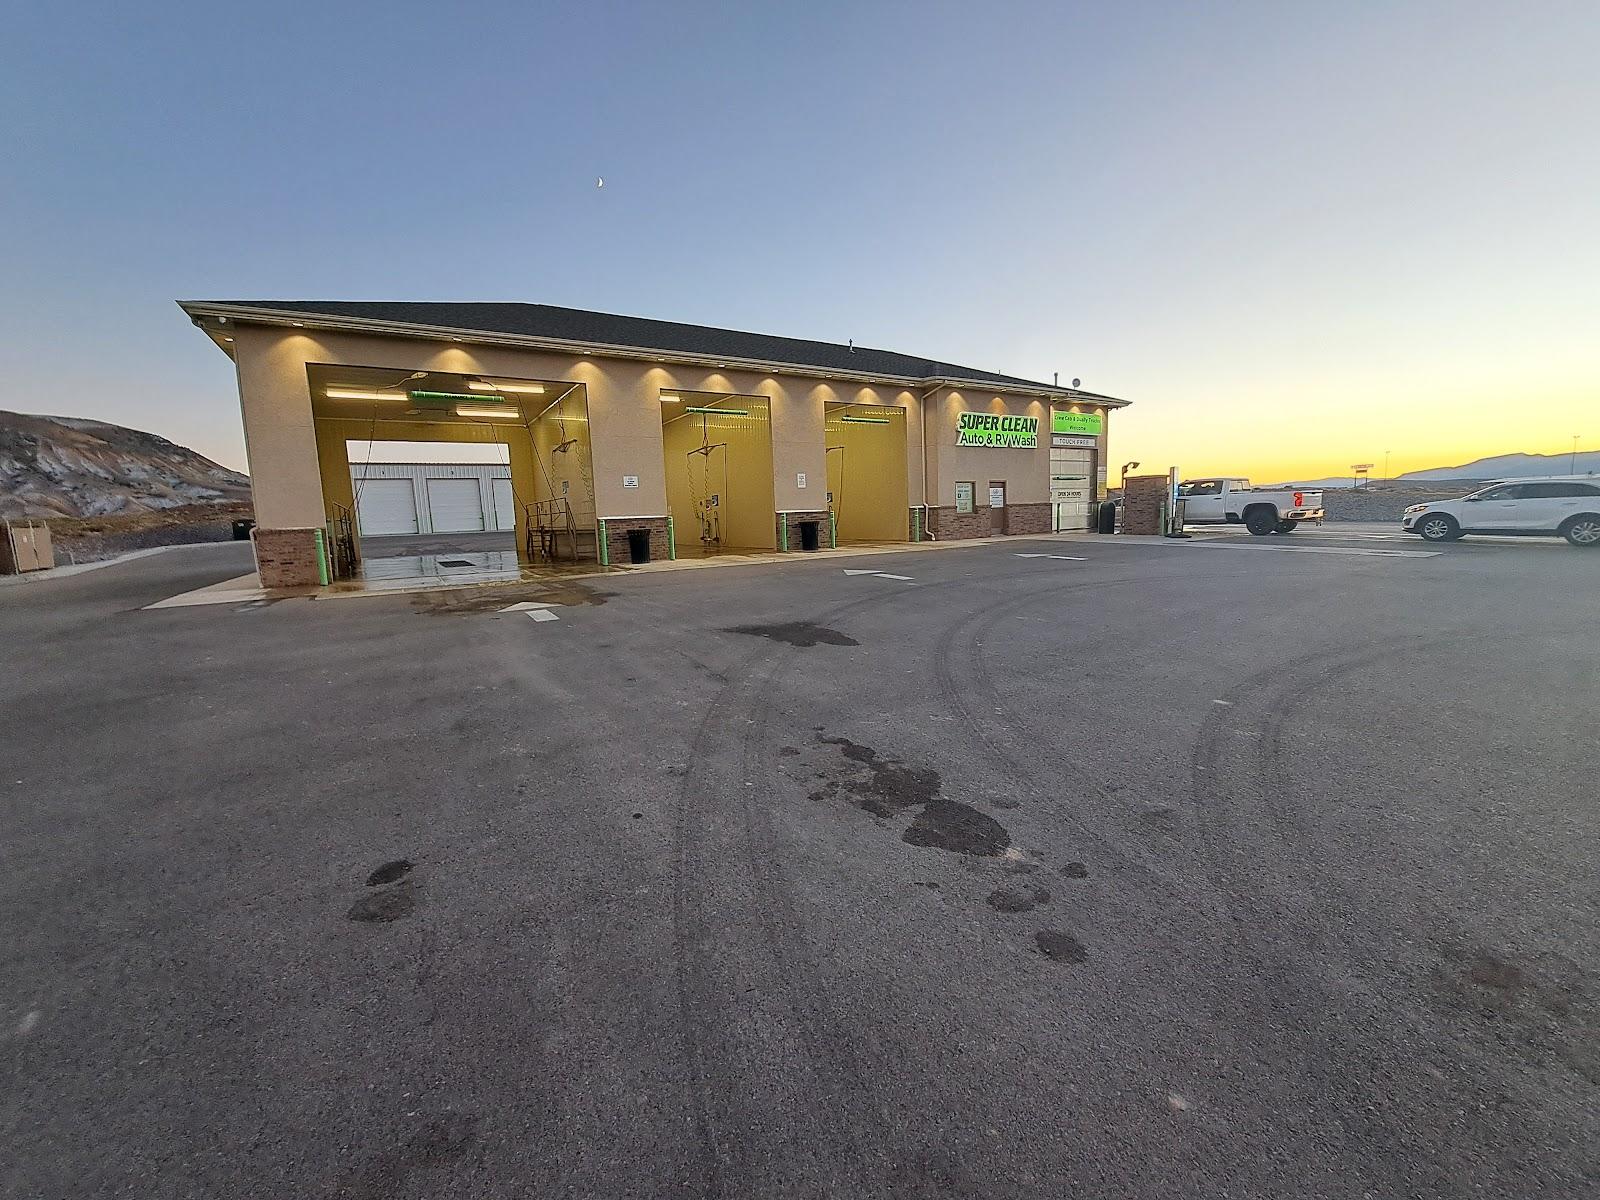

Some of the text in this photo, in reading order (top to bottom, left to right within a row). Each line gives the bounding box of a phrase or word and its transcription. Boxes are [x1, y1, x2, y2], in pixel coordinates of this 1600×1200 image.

[959, 414, 1038, 433] SUPER CLEAN
[960, 432, 1036, 447] Auto & RV Wash
